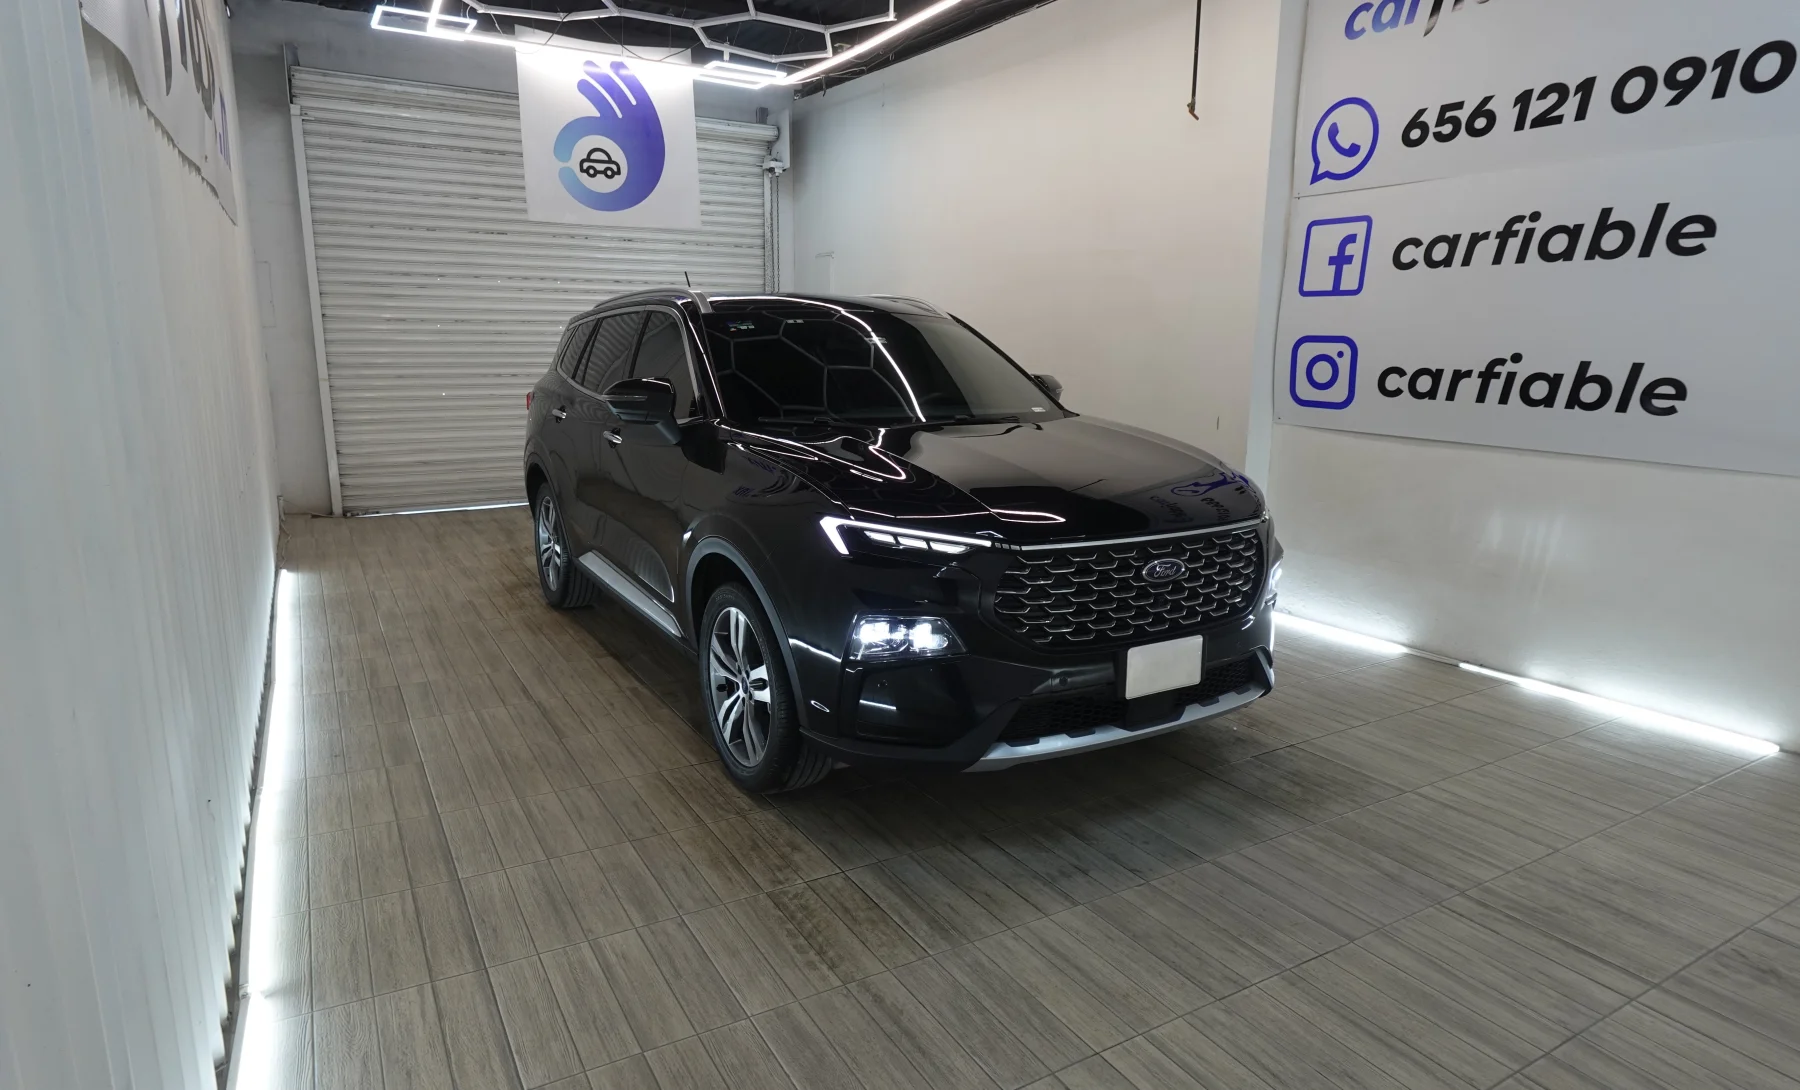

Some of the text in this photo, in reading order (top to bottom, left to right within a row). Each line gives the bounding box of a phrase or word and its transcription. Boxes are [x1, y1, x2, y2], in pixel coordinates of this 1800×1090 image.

[1401, 40, 1798, 148] 656 121 0910
[1392, 202, 1717, 271] carfiable
[1377, 352, 1688, 417] carfiable
[1153, 563, 1177, 578] Ford
